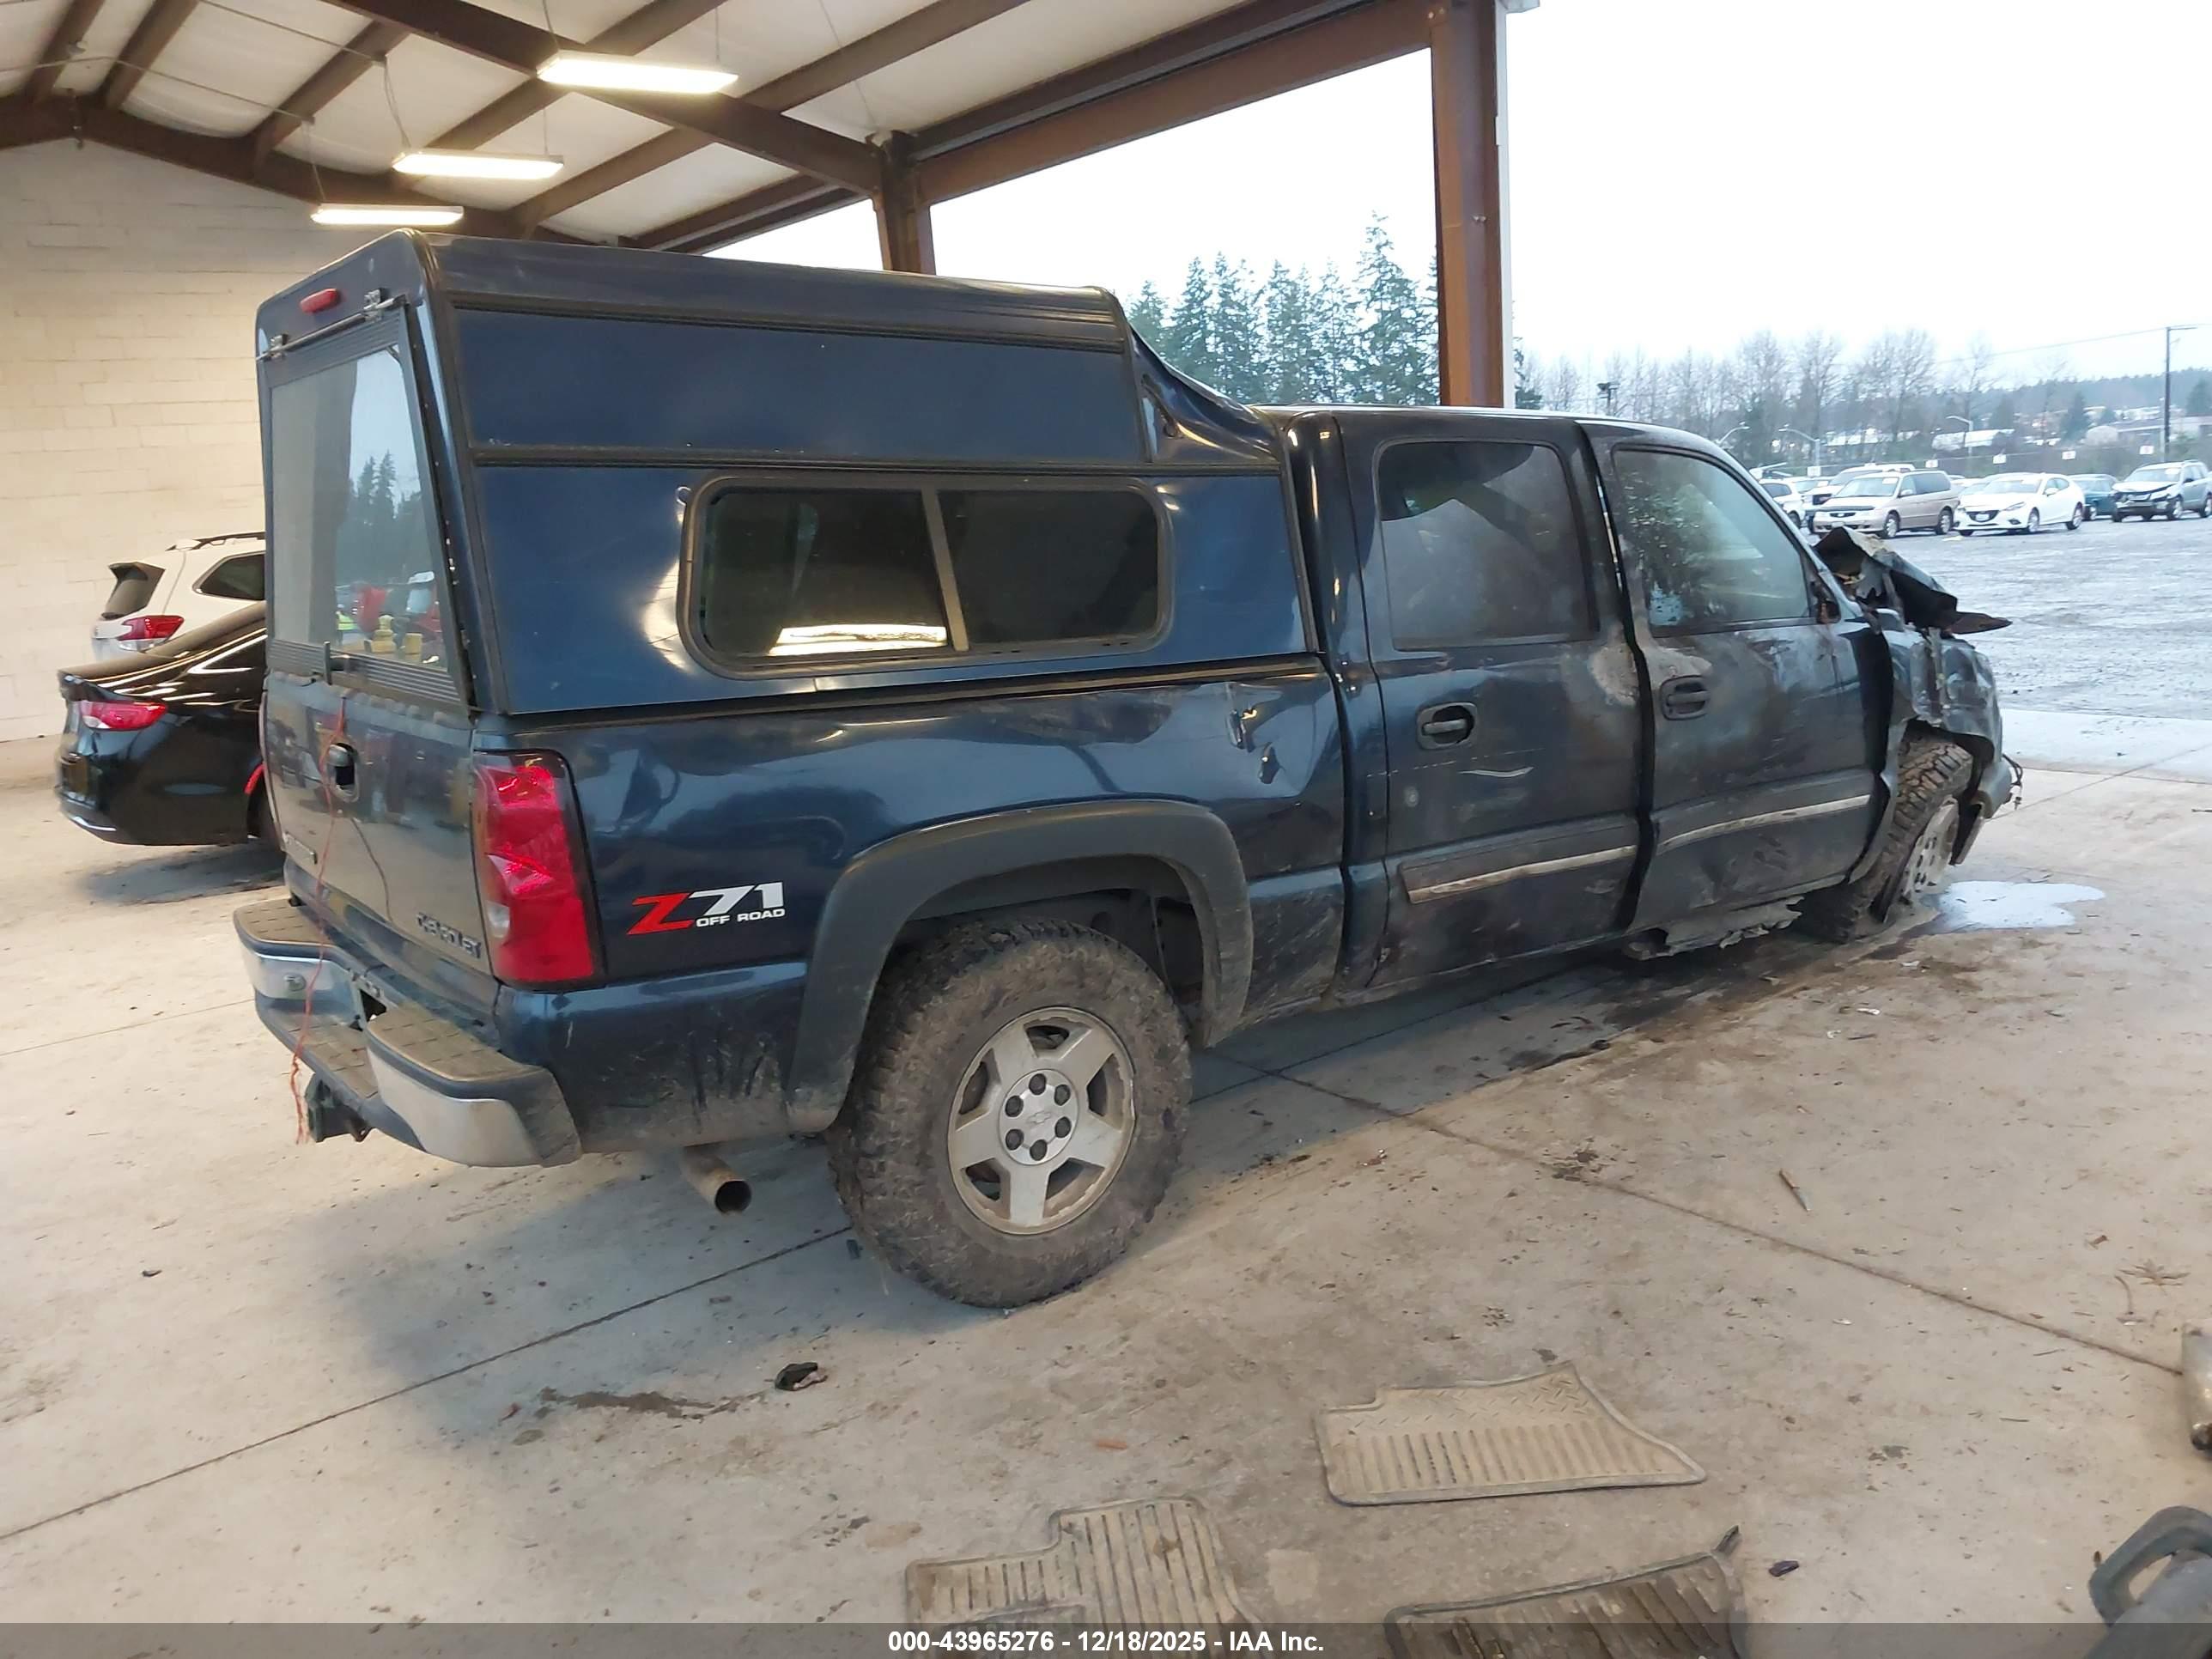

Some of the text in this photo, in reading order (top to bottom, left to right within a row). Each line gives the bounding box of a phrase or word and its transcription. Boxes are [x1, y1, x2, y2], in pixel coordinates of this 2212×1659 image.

[626, 881, 784, 935] Z71
[696, 908, 786, 927] OFF ROAD
